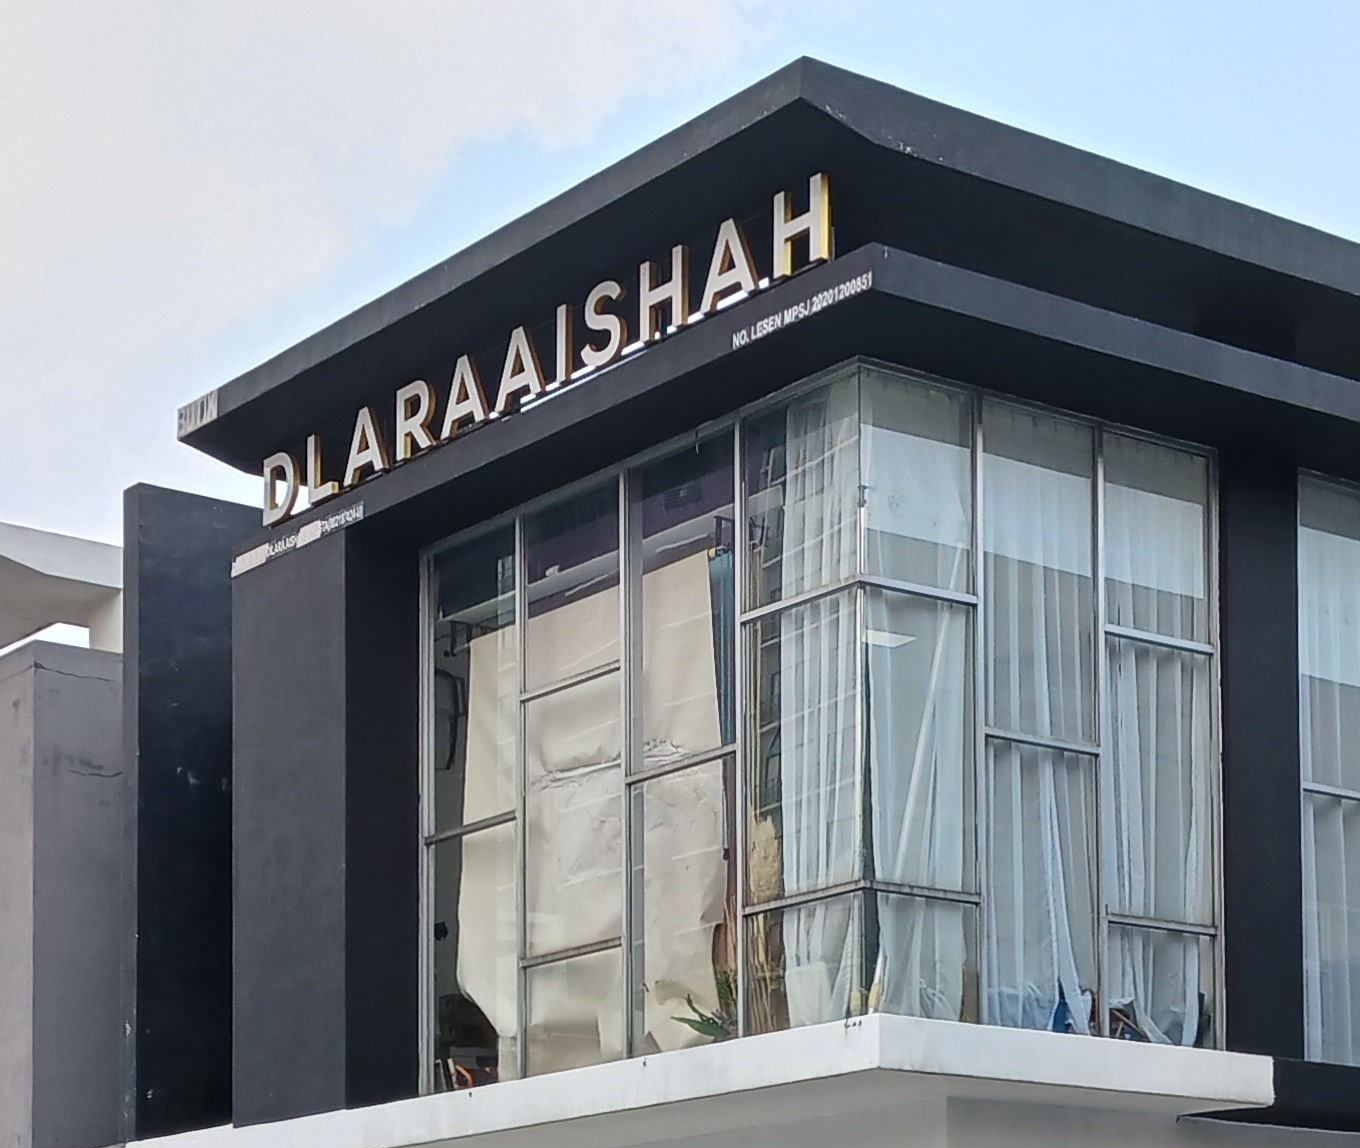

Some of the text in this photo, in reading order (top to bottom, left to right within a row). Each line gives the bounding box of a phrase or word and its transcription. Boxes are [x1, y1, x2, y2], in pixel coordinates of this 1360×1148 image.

[262, 171, 831, 528] DLARAAISHAH
[732, 329, 749, 350] NO.
[750, 312, 782, 341] LESEN
[783, 299, 810, 326] MPSJ
